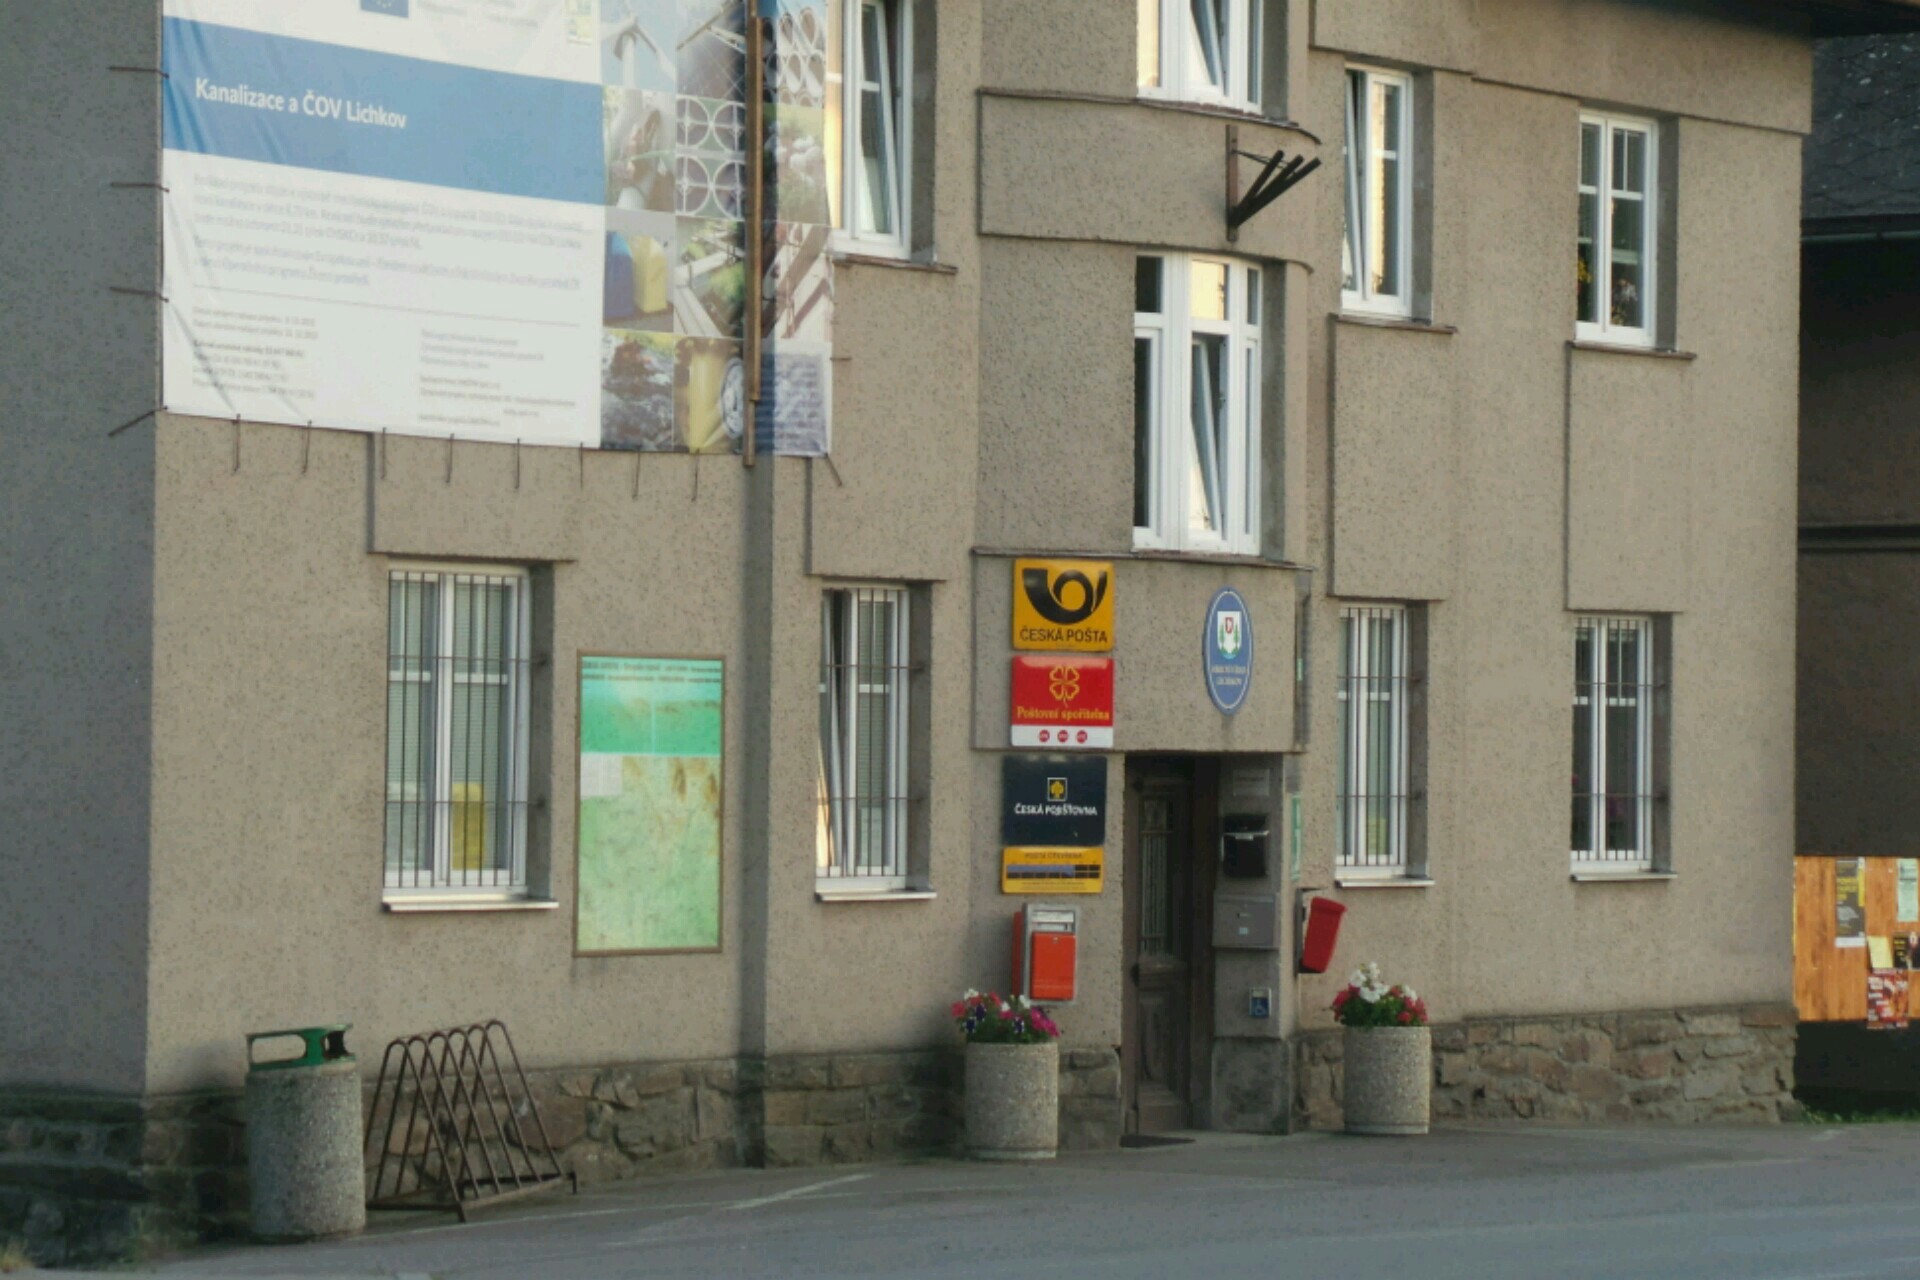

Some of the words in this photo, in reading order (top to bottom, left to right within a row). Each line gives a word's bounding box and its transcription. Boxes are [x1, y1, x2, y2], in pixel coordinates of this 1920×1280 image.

[196, 77, 285, 111] Kanalizace
[288, 97, 299, 113] a
[303, 89, 342, 120] ČOV
[346, 100, 407, 128] Lichkov
[1020, 626, 1063, 641] ČESKÁ
[1066, 626, 1108, 643] POŠTA
[1017, 706, 1059, 720] Poštovní
[1062, 707, 1109, 721] spořitelna
[1014, 802, 1044, 815] ČESKÁ
